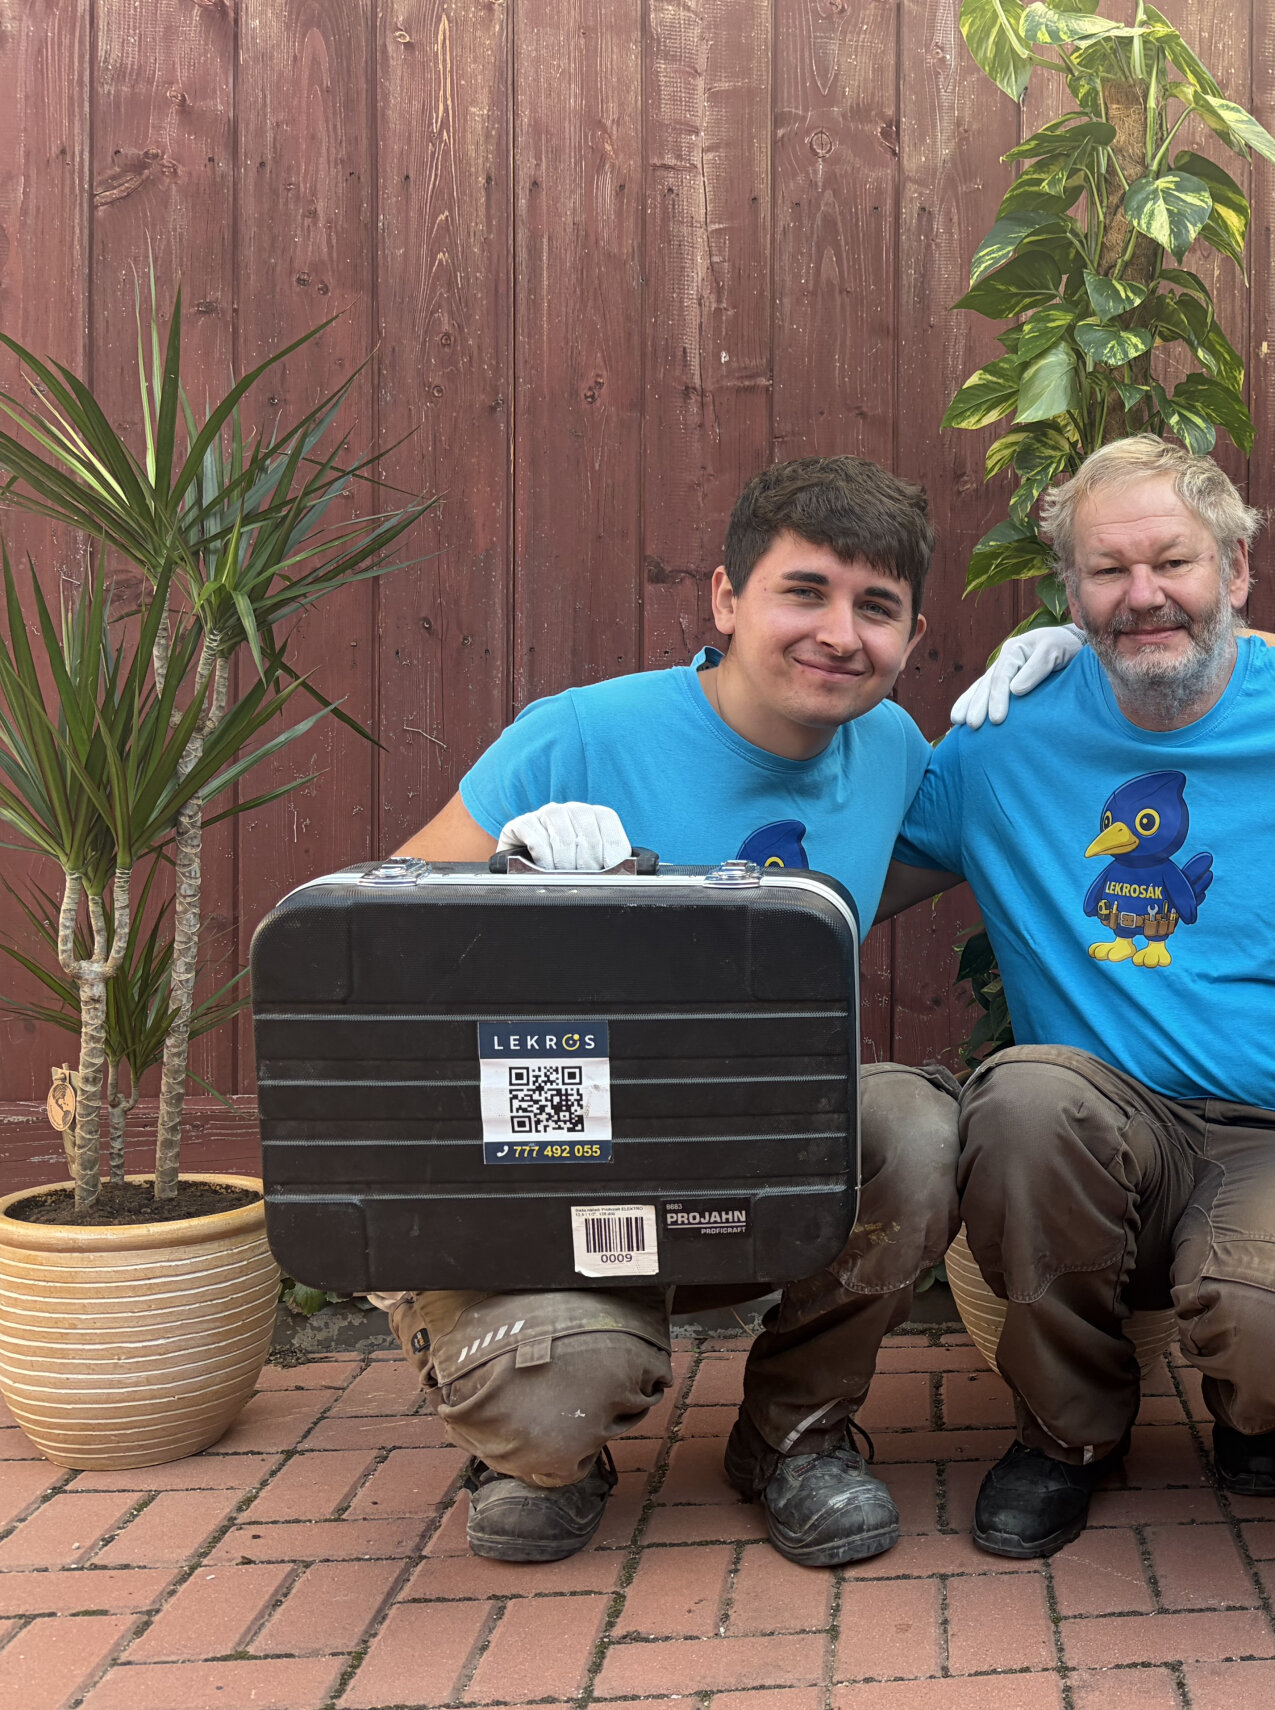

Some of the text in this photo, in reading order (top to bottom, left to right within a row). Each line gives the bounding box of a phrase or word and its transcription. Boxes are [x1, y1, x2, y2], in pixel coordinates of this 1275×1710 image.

[1105, 880, 1163, 900] LEKROSÁK
[493, 1033, 596, 1051] LEKROS
[513, 1145, 601, 1158] 777 492 055
[666, 1210, 746, 1225] PROJAHN
[700, 1226, 746, 1235] PROFICRAFT
[600, 1253, 633, 1264] 0009
